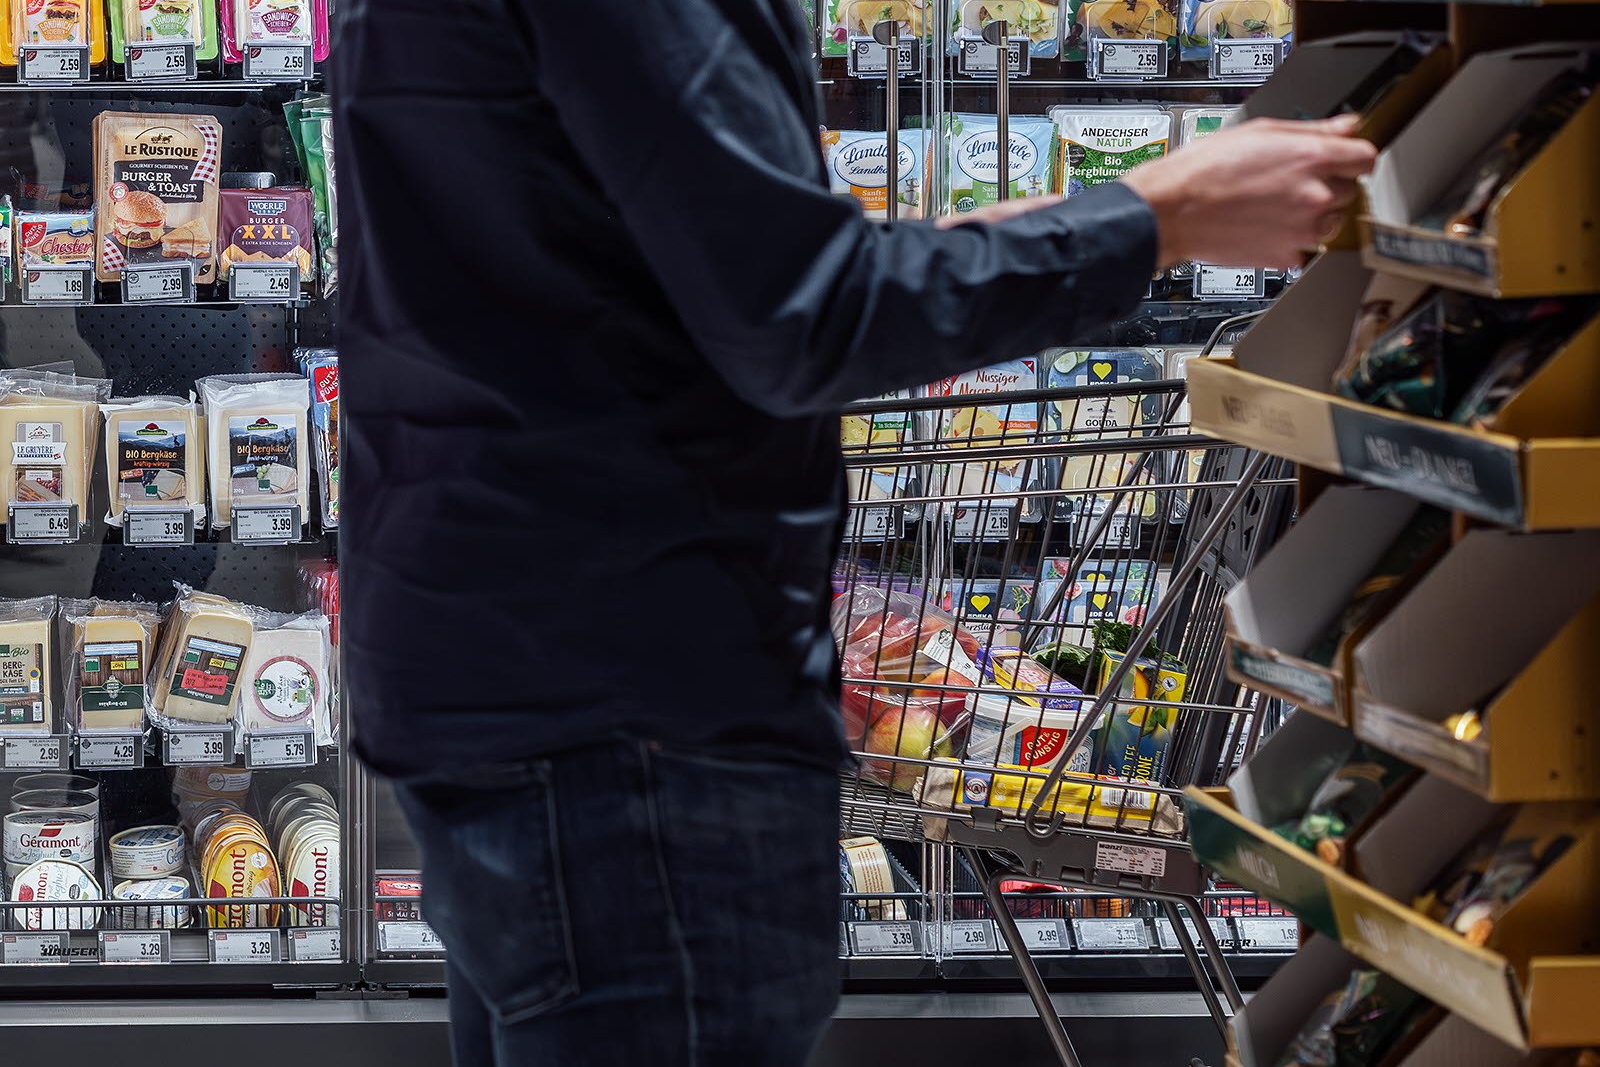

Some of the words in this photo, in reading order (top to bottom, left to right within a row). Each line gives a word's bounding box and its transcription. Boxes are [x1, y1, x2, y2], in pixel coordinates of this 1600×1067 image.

[1254, 52, 1273, 66] 2.59
[1081, 127, 1149, 138] ANDECHSER
[1096, 138, 1133, 148] NATUR
[124, 144, 138, 155] LE
[139, 142, 199, 158] RUSTIQUE
[1104, 156, 1123, 166] Bio
[121, 171, 172, 183] BURGER
[250, 202, 284, 212] WOERLE
[249, 217, 285, 225] BURGER
[40, 236, 92, 255] Chester
[1235, 273, 1255, 287] 2.29
[975, 369, 1019, 385] Nussiger
[1085, 418, 1118, 428] GOUDA
[125, 449, 140, 459] BIO
[141, 448, 178, 461] Bergkäse
[49, 517, 69, 531] 6.49
[990, 517, 1008, 530] 2.19
[10, 646, 30, 657] Bio
[2, 660, 26, 669] BERG-
[113, 744, 134, 757] 4.29
[285, 743, 305, 757] 5.79
[19, 831, 82, 849] Géramont
[892, 931, 912, 944] 3.39
[140, 942, 160, 956] 3.29
